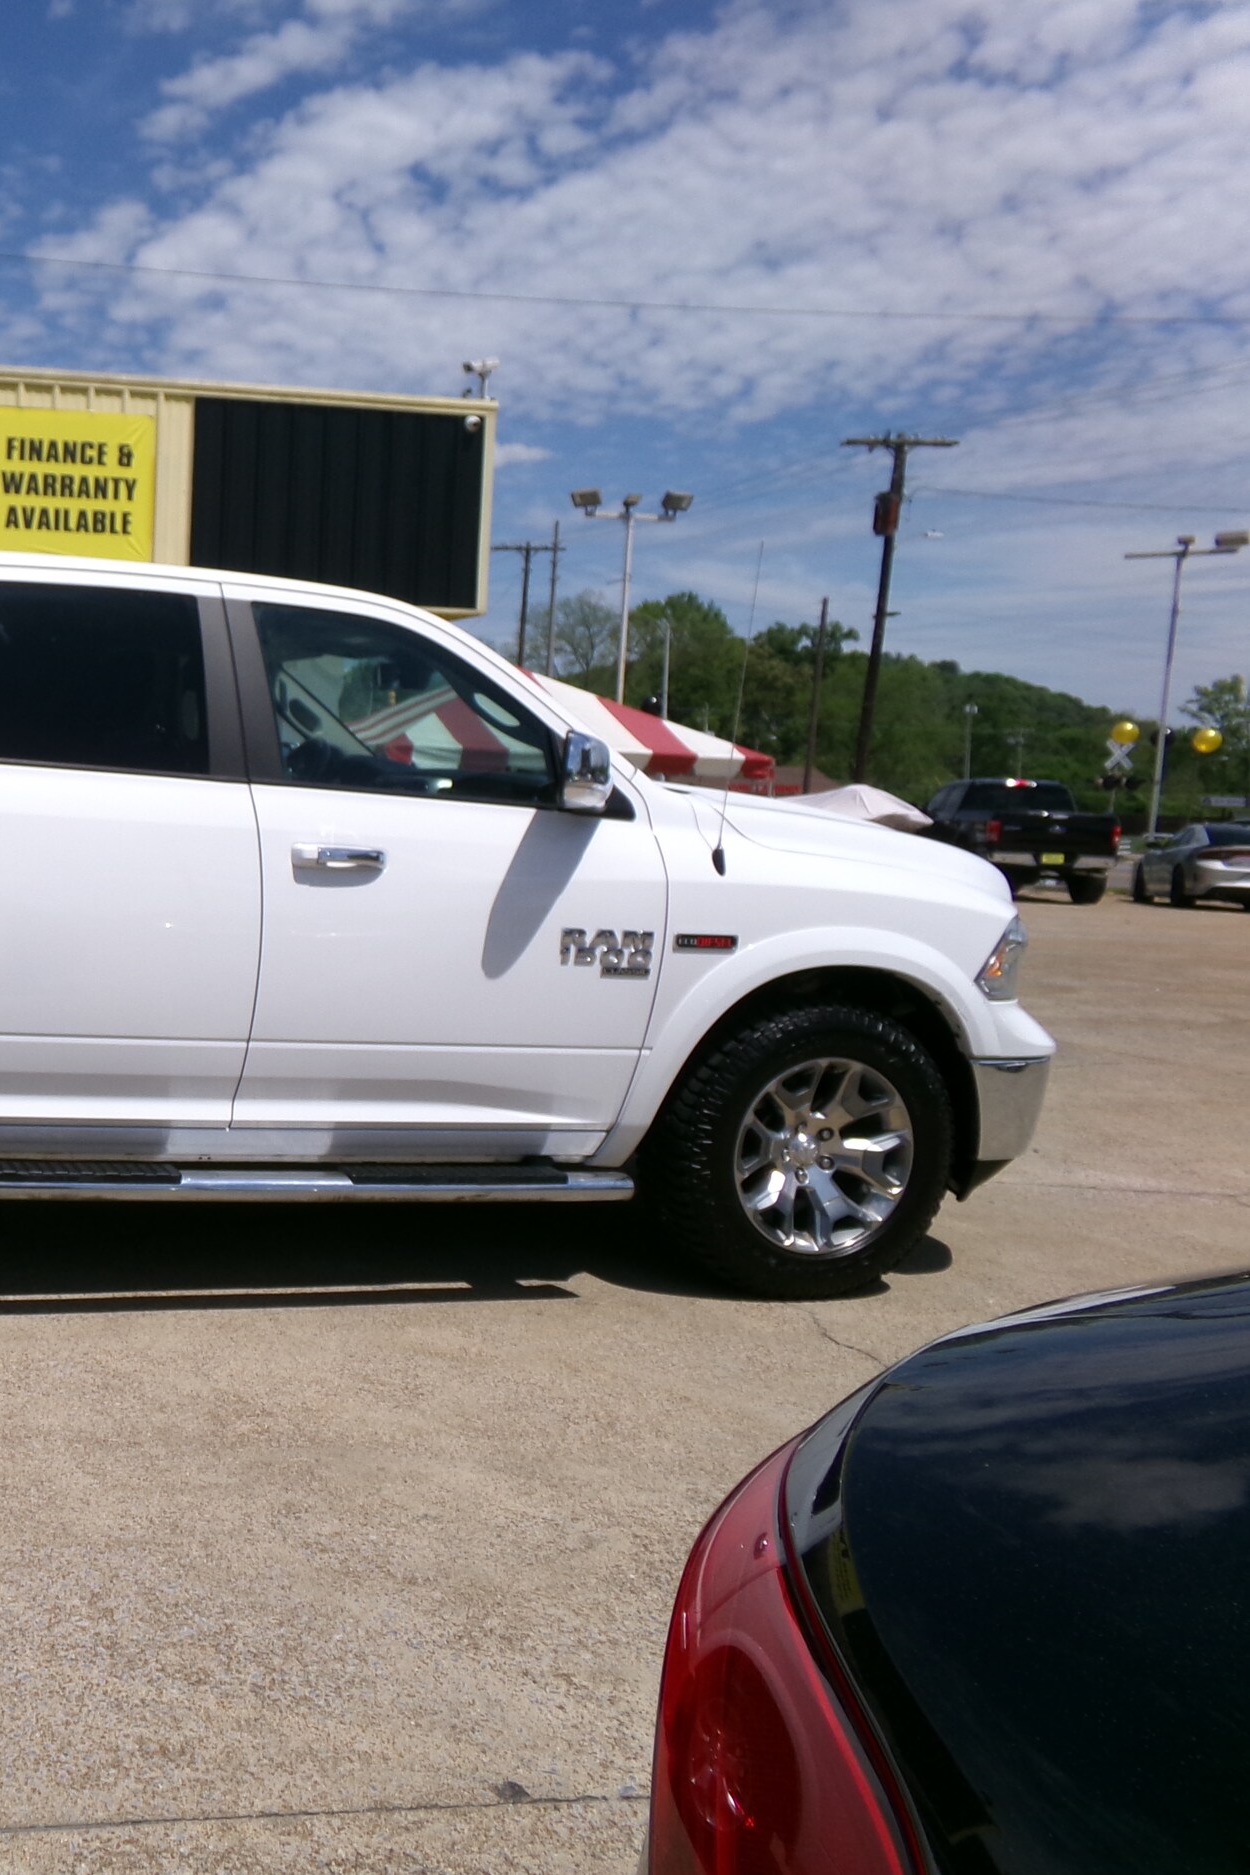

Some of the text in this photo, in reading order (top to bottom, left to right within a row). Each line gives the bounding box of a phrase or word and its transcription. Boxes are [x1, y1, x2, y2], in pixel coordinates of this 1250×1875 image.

[6, 437, 134, 468] FINANCE &
[1, 470, 137, 502] WARRANTY
[5, 505, 133, 536] AVAILABLE
